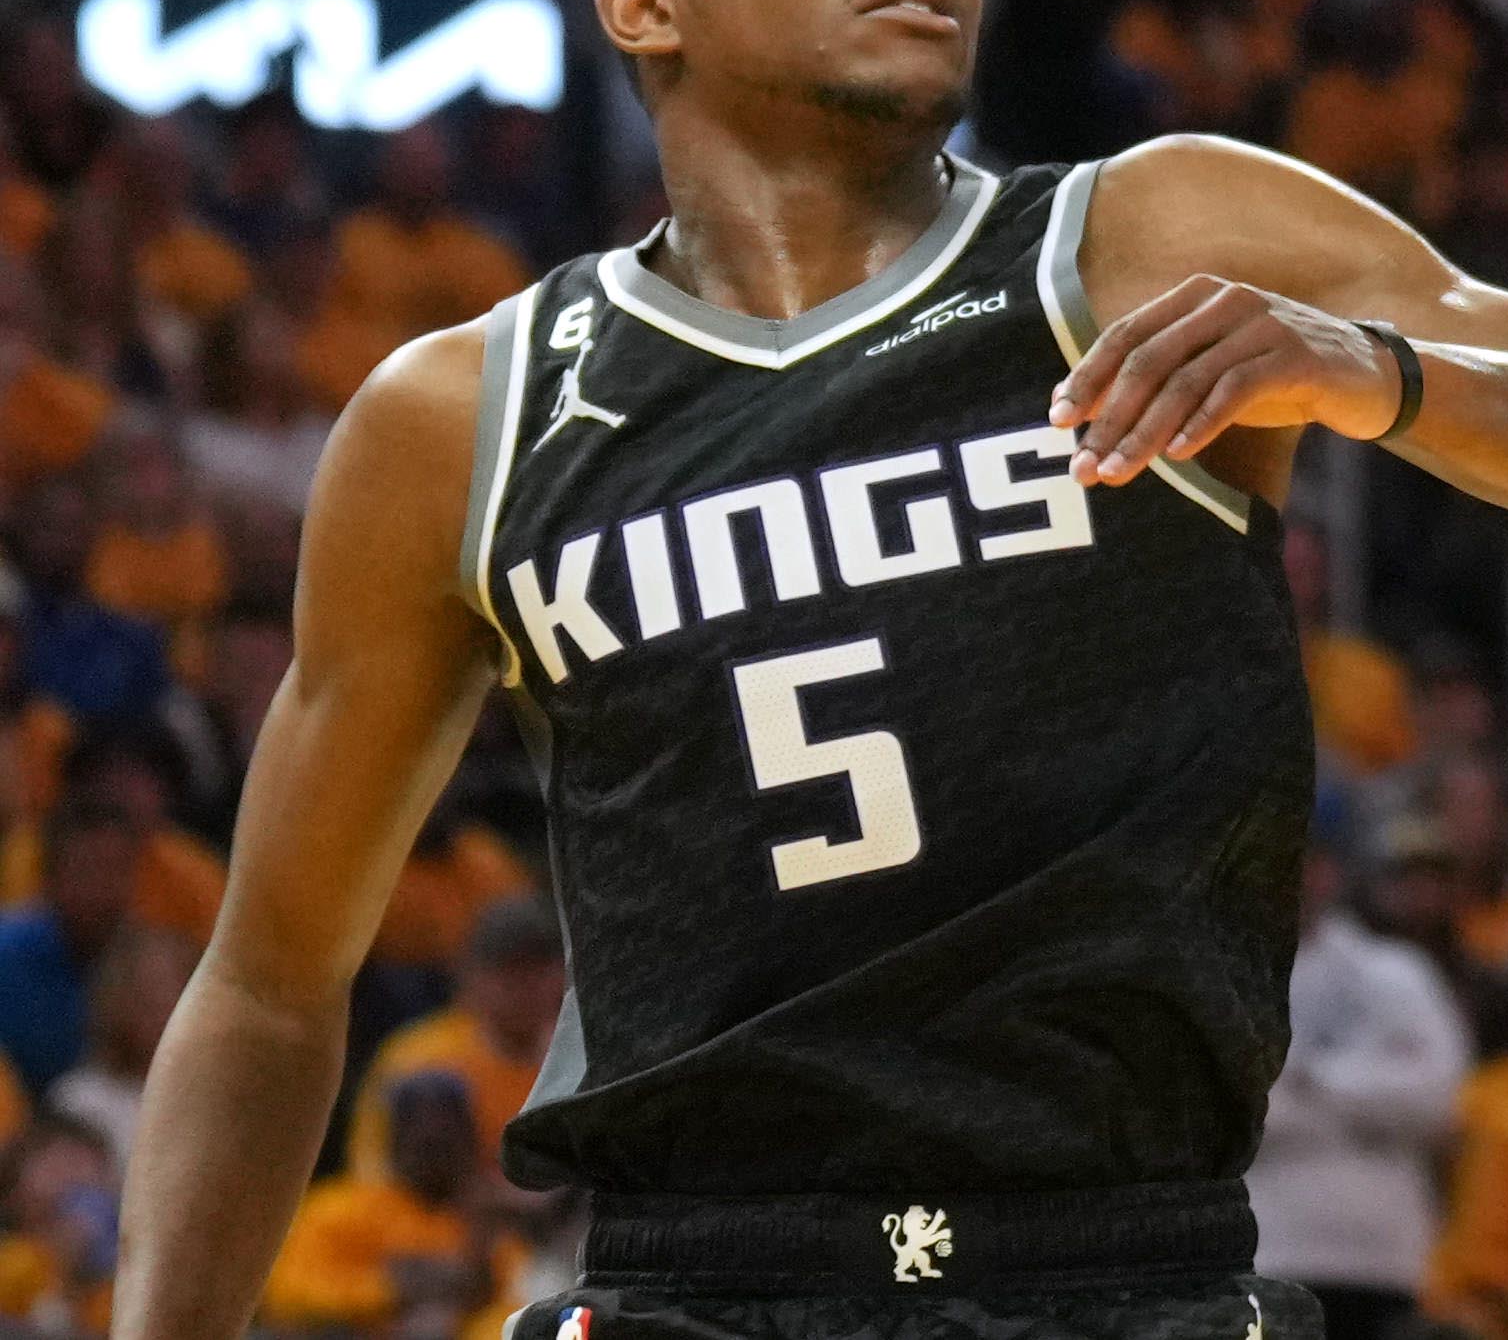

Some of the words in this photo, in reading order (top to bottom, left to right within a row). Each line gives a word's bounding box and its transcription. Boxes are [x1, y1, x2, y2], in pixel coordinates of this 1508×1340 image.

[548, 296, 594, 349] 6
[865, 289, 1007, 356] dialpad
[506, 425, 1094, 685] KINGS
[733, 637, 921, 891] 5
